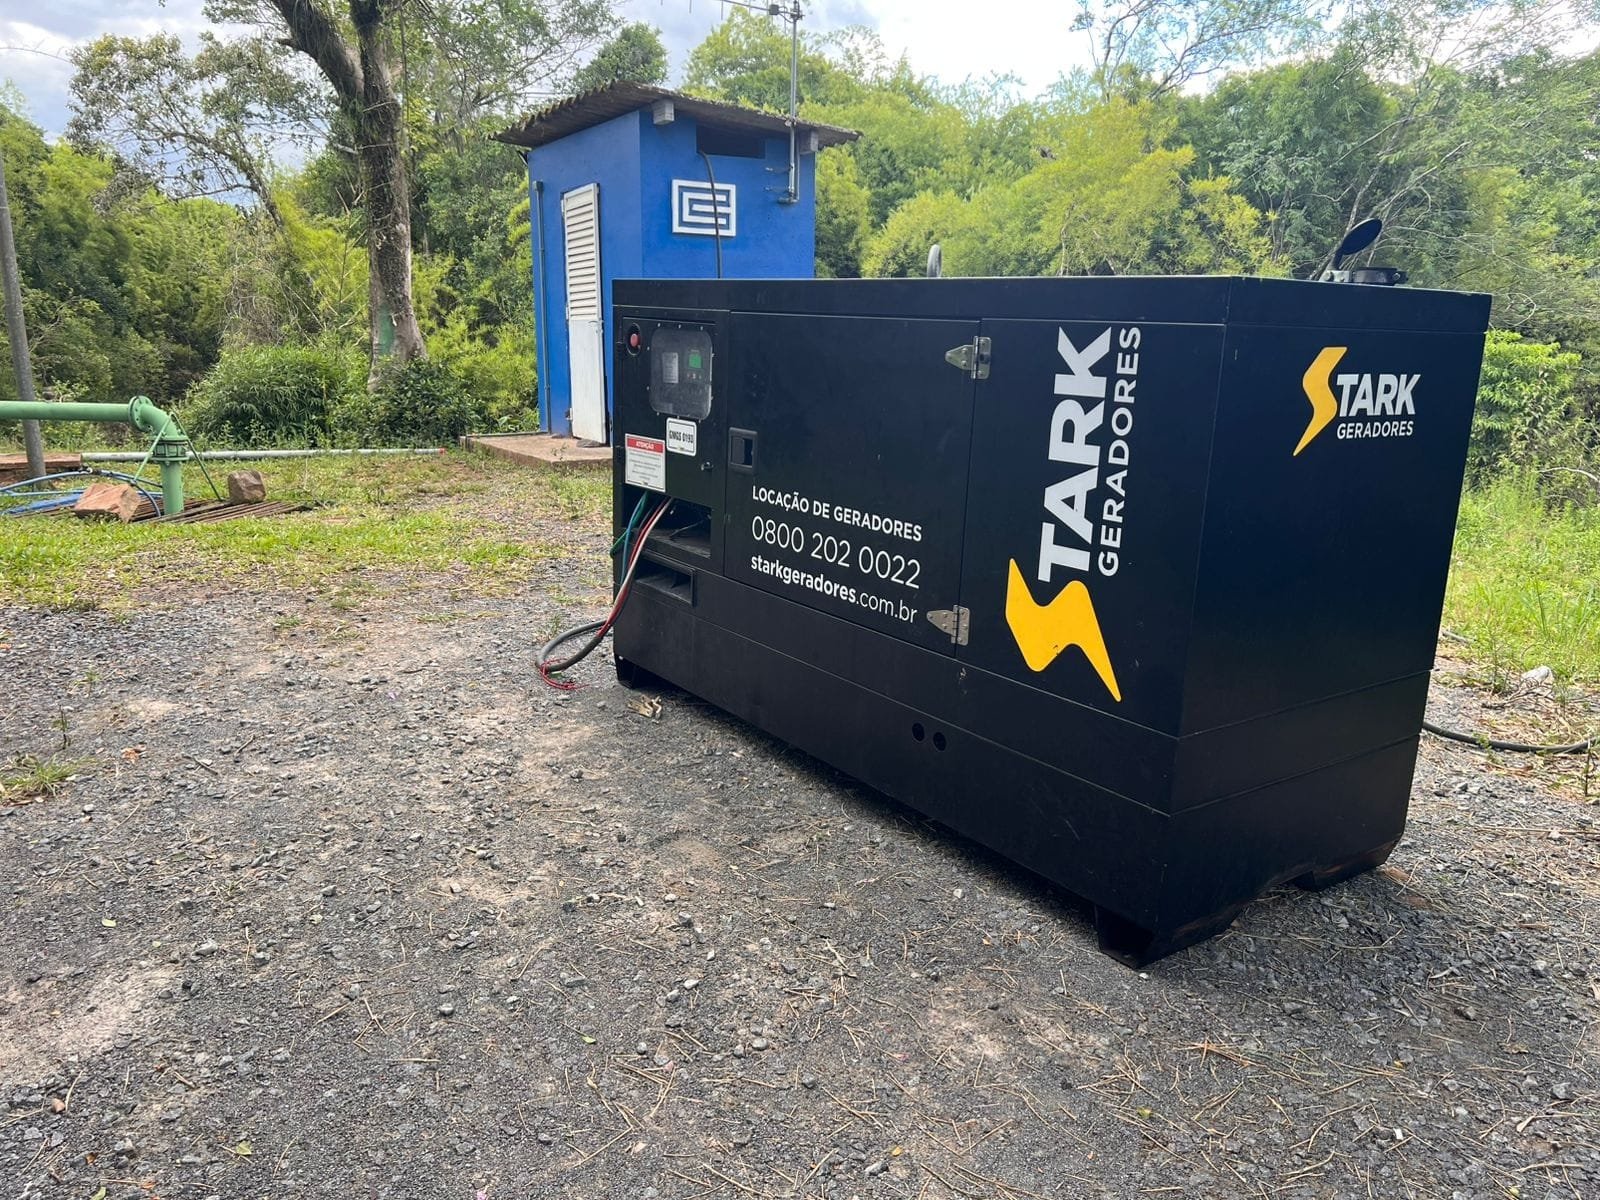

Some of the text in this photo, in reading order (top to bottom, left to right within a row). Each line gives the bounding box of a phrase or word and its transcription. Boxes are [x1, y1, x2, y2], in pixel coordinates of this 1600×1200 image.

[1098, 327, 1141, 577] GERADORES
[1336, 420, 1414, 439] GERADORES
[752, 485, 922, 542] LOCAÇÃO DE GERADORES
[752, 515, 921, 590] 0800 202 0022
[750, 554, 918, 623] starkgeradores.com.br
